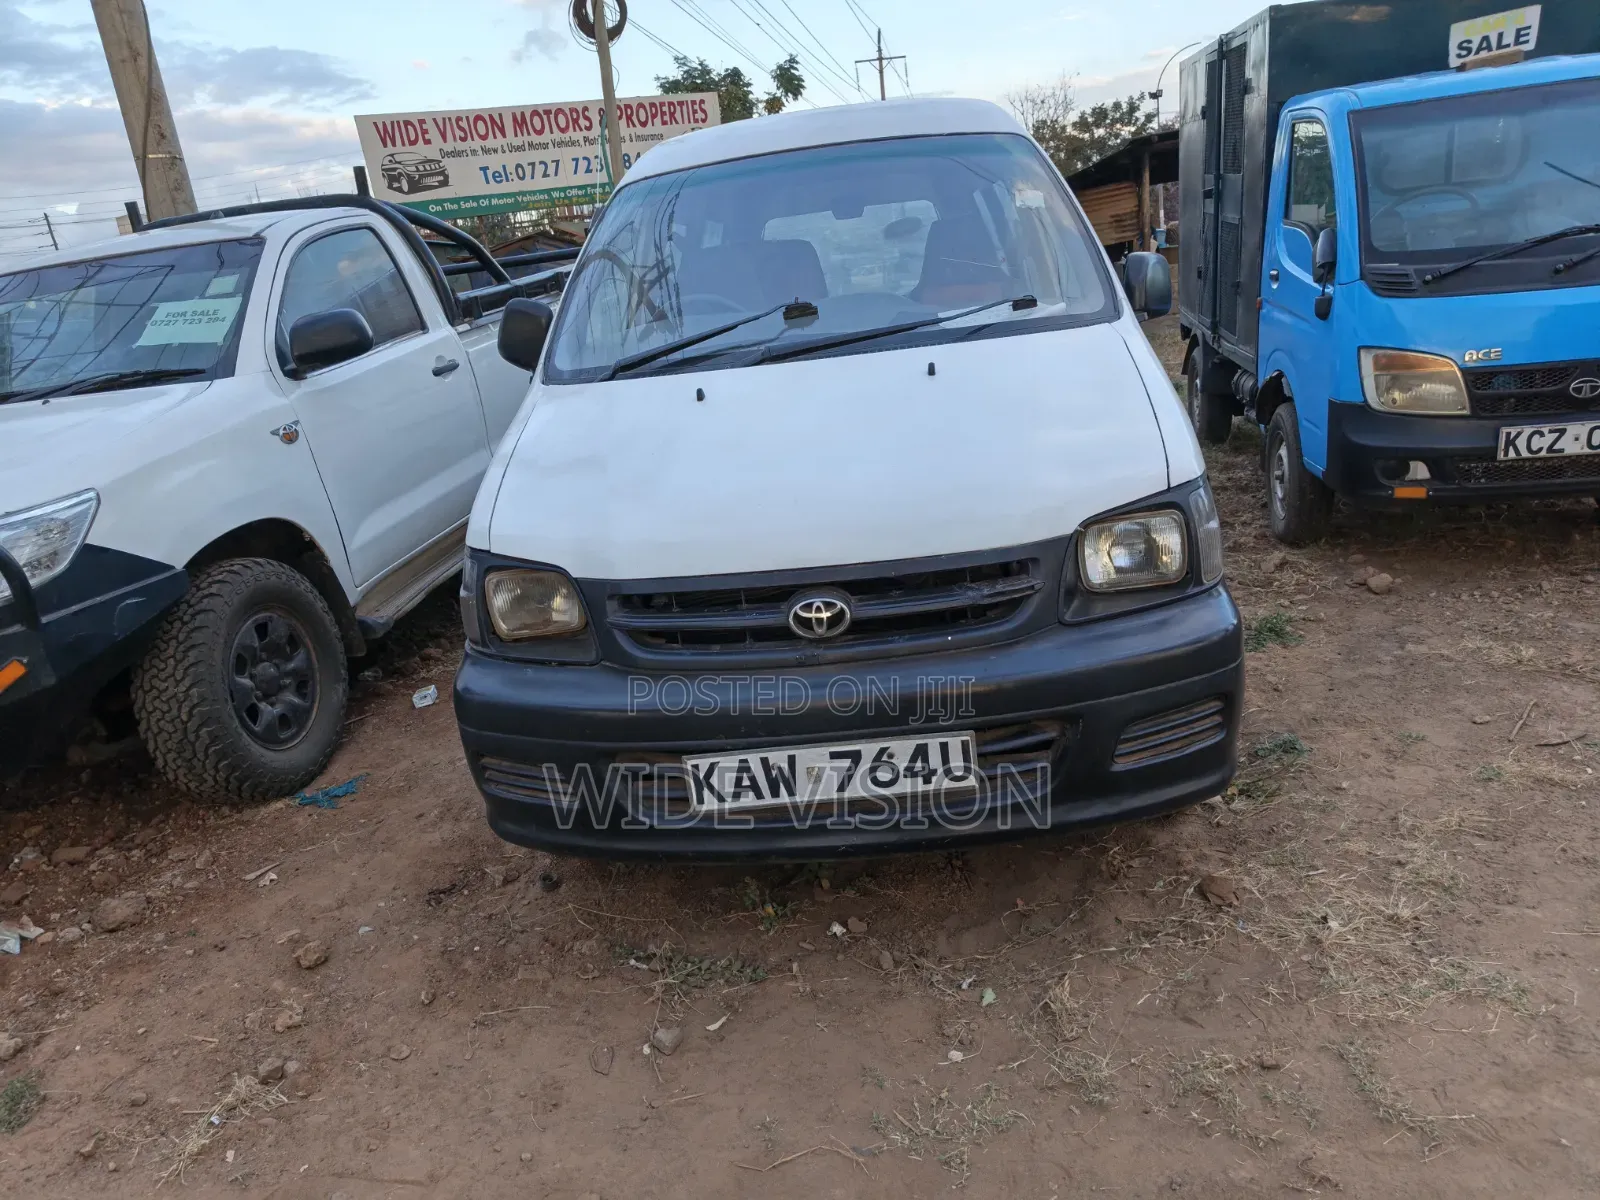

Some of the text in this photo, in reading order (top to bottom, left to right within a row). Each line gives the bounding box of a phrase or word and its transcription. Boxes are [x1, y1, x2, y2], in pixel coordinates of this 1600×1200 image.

[1455, 25, 1532, 59] SALE
[373, 118, 432, 148] WIDE
[432, 112, 507, 143] VISION
[511, 106, 593, 138] MOTORS
[616, 98, 709, 129] PROPERTIES
[439, 147, 469, 159] Dealers
[470, 145, 480, 157] in:
[481, 145, 499, 157] New
[500, 144, 507, 154] &
[507, 141, 527, 154] Used
[527, 139, 550, 151] Motor
[551, 136, 583, 150] Vehicles,
[629, 134, 634, 143] &
[635, 131, 664, 143] Insurance
[571, 155, 604, 176] 723
[429, 204, 441, 213] On
[443, 202, 458, 211] The
[461, 200, 478, 209] Sale
[480, 197, 489, 207] Of
[491, 197, 515, 206] Motor
[551, 190, 565, 199] We
[566, 187, 586, 197] Offer
[150, 319, 179, 327] 0727
[165, 309, 220, 318] FOR SALE
[1464, 348, 1502, 362] ACE
[1503, 428, 1567, 458] KCZ
[690, 738, 973, 806] KAW 764U
